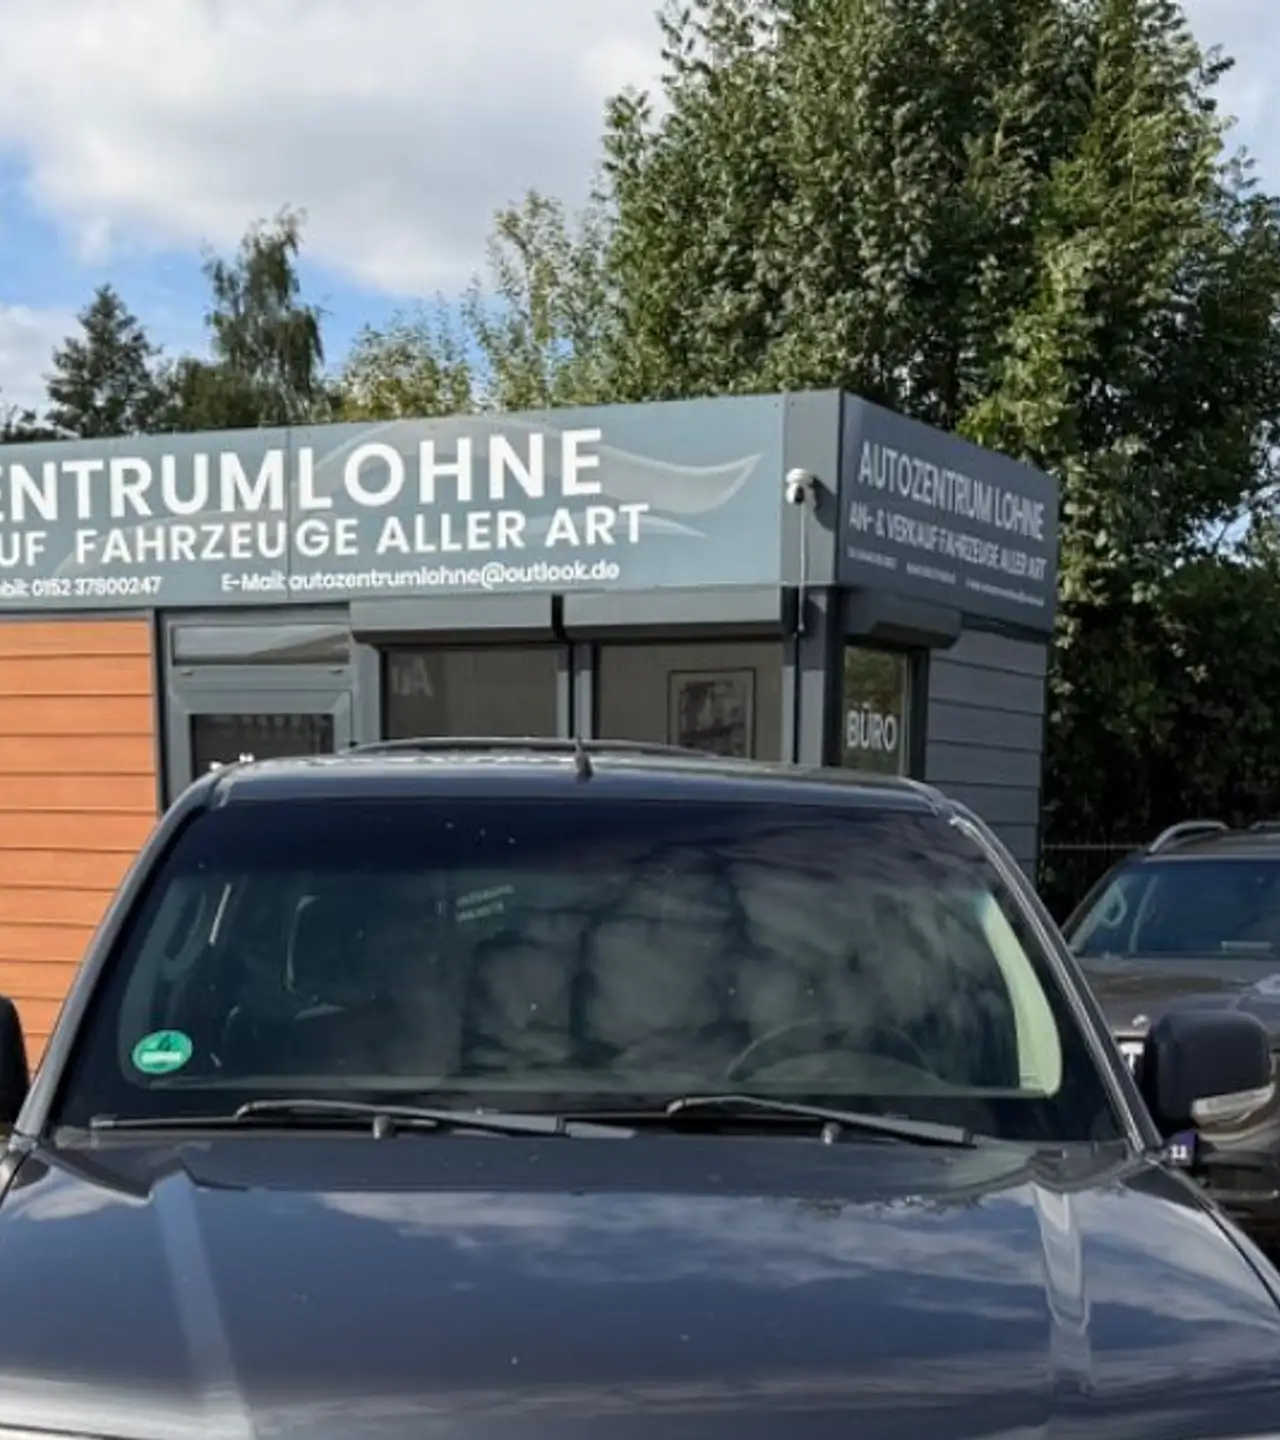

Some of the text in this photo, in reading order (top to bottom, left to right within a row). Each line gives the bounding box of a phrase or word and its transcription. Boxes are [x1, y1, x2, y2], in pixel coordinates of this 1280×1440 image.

[857, 440, 1046, 542] AUTOZENTRUM LOHNE
[75, 518, 359, 564] FAHRZEUGE
[377, 510, 526, 556] ALLER
[545, 503, 650, 547] ART
[288, 561, 621, 591] autozentrumlohne@outlook.de
[845, 702, 898, 753] BÜRO
